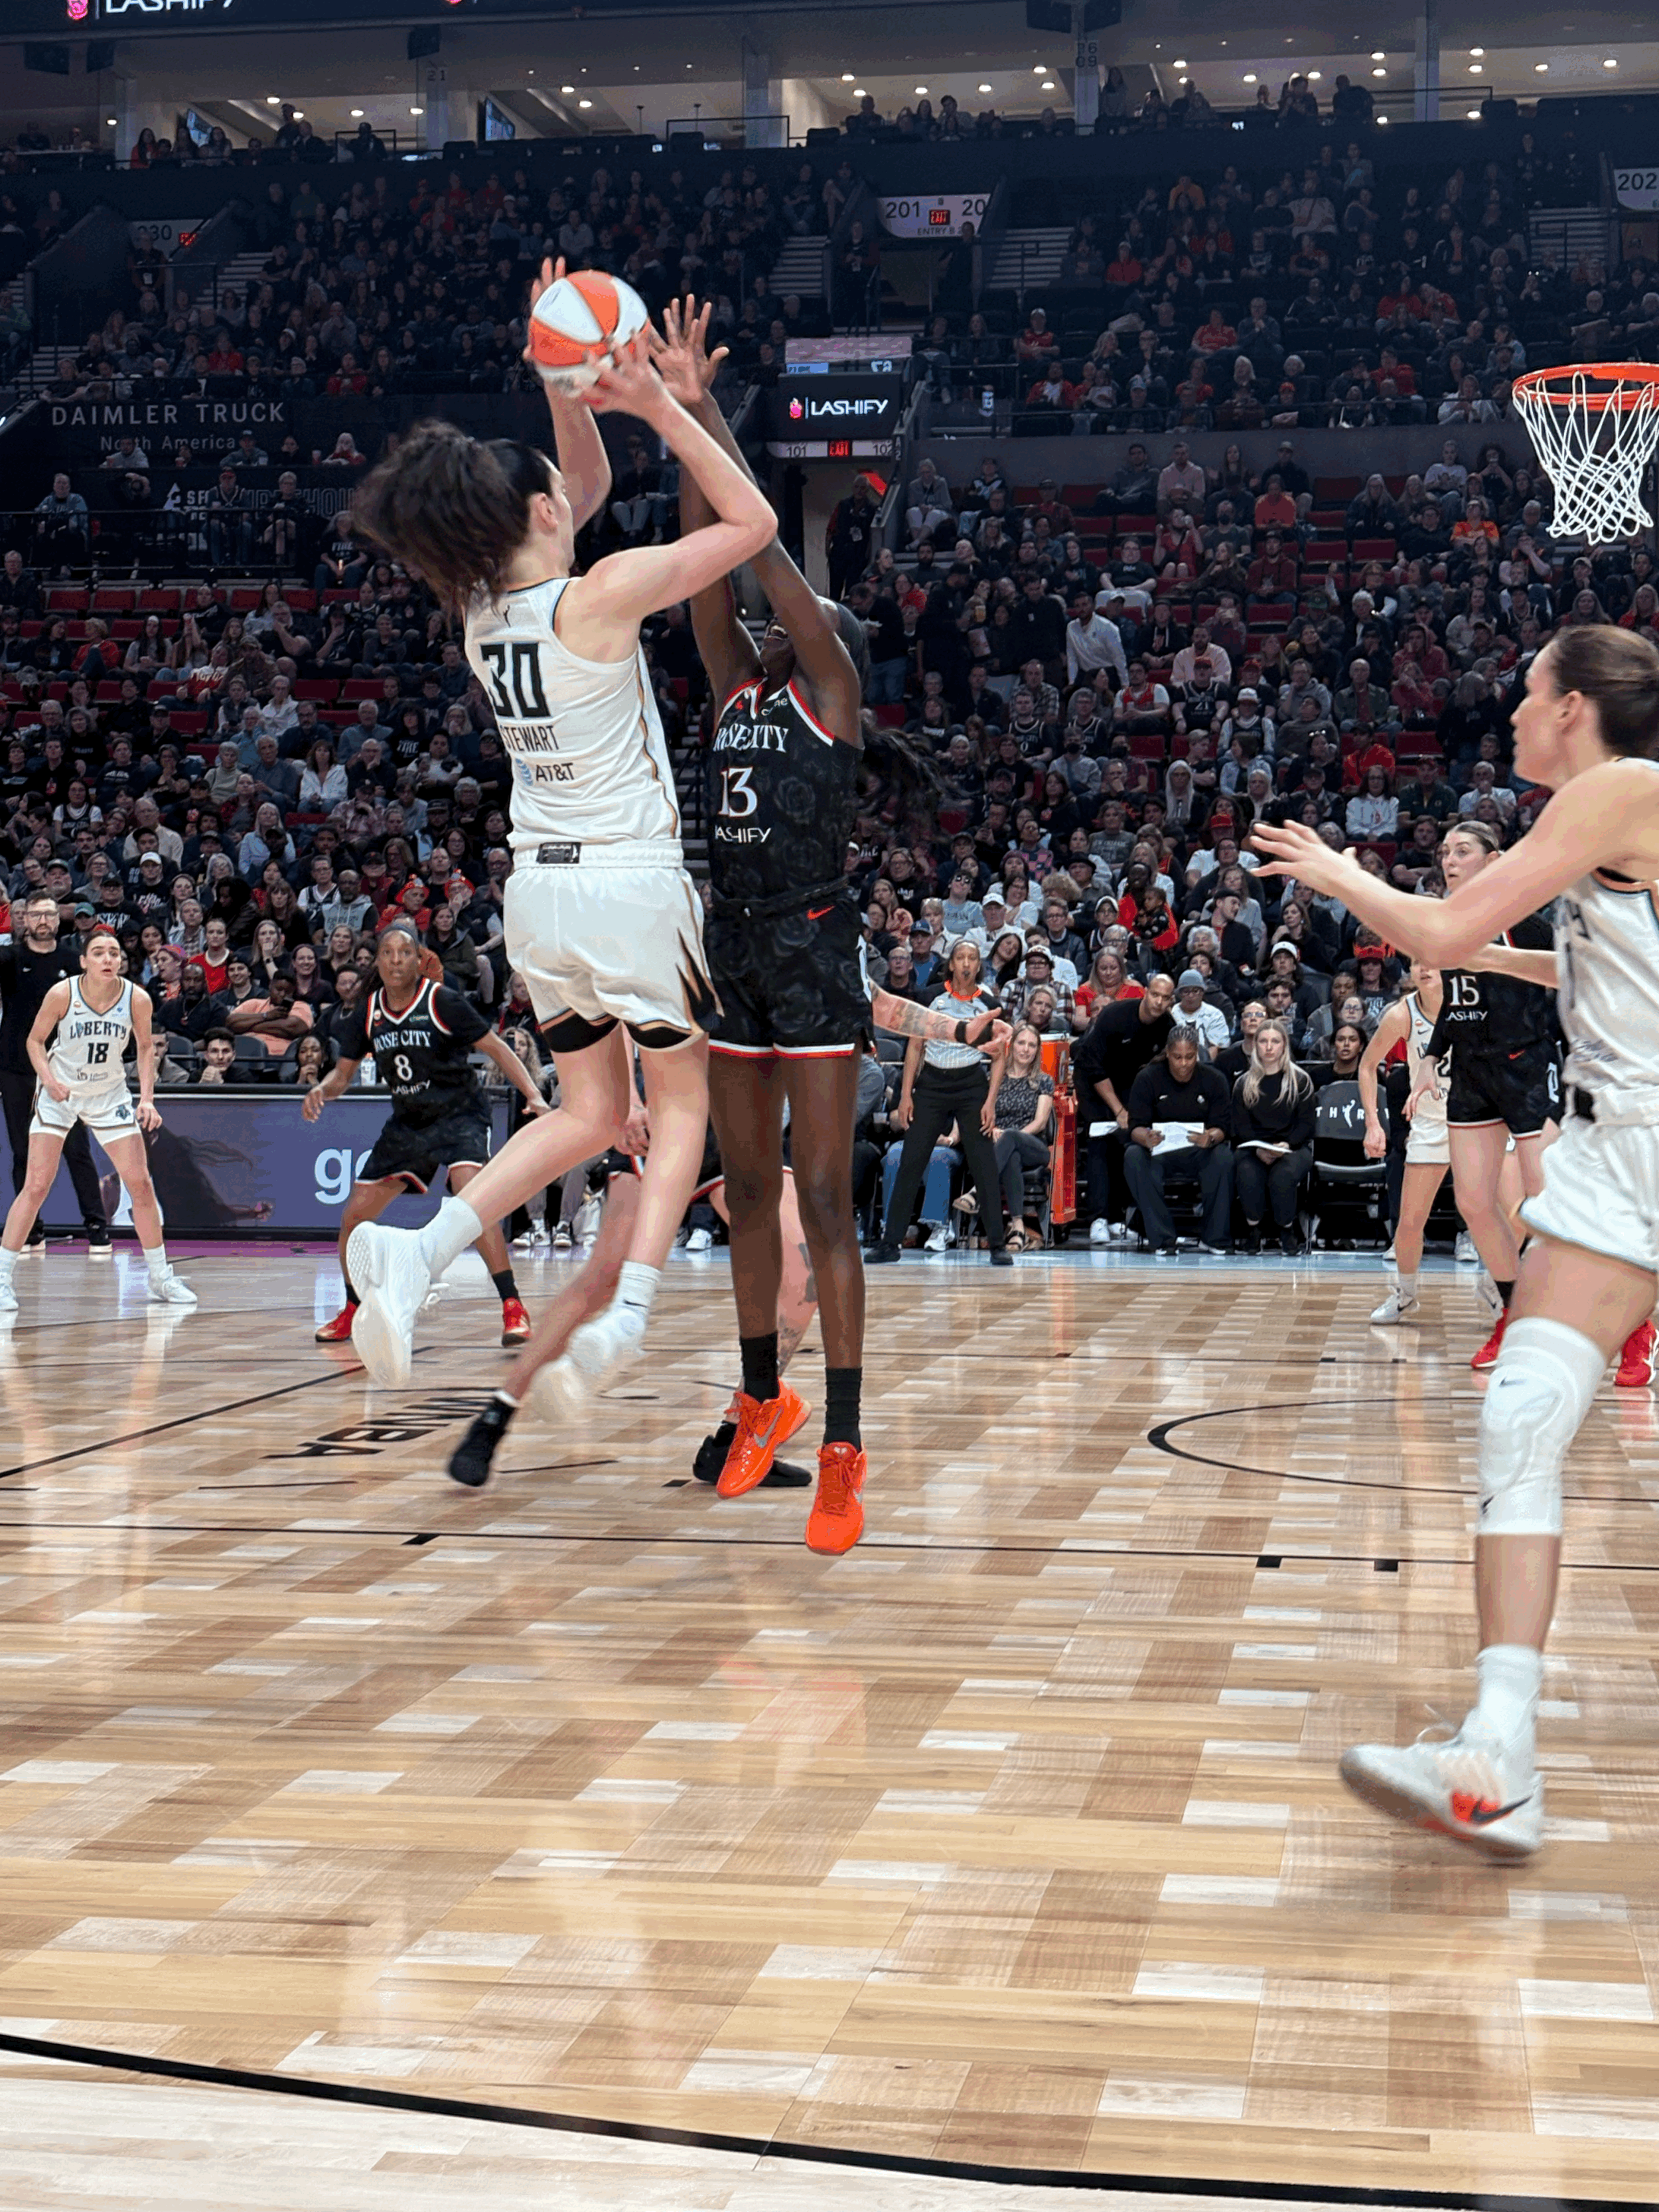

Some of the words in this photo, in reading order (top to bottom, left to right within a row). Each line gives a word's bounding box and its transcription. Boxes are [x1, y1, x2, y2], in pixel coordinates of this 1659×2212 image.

[105, 0, 232, 13] LASH
[1618, 173, 1657, 191] 202
[886, 201, 920, 218] 201
[963, 199, 986, 216] 20
[52, 404, 178, 425] DAIMLER
[195, 402, 284, 423] TRUCK
[810, 399, 889, 415] LASHIFY
[100, 435, 152, 451] Noth
[161, 434, 236, 451] America
[480, 642, 551, 718] 30
[499, 725, 559, 752] STEWART
[536, 763, 574, 782] AT&T
[715, 767, 758, 818] 13
[1449, 975, 1480, 1007] 15
[70, 1020, 127, 1040] LIBERTY
[400, 1029, 431, 1048] CITY
[87, 1042, 109, 1065] 18
[394, 1053, 413, 1082] 8
